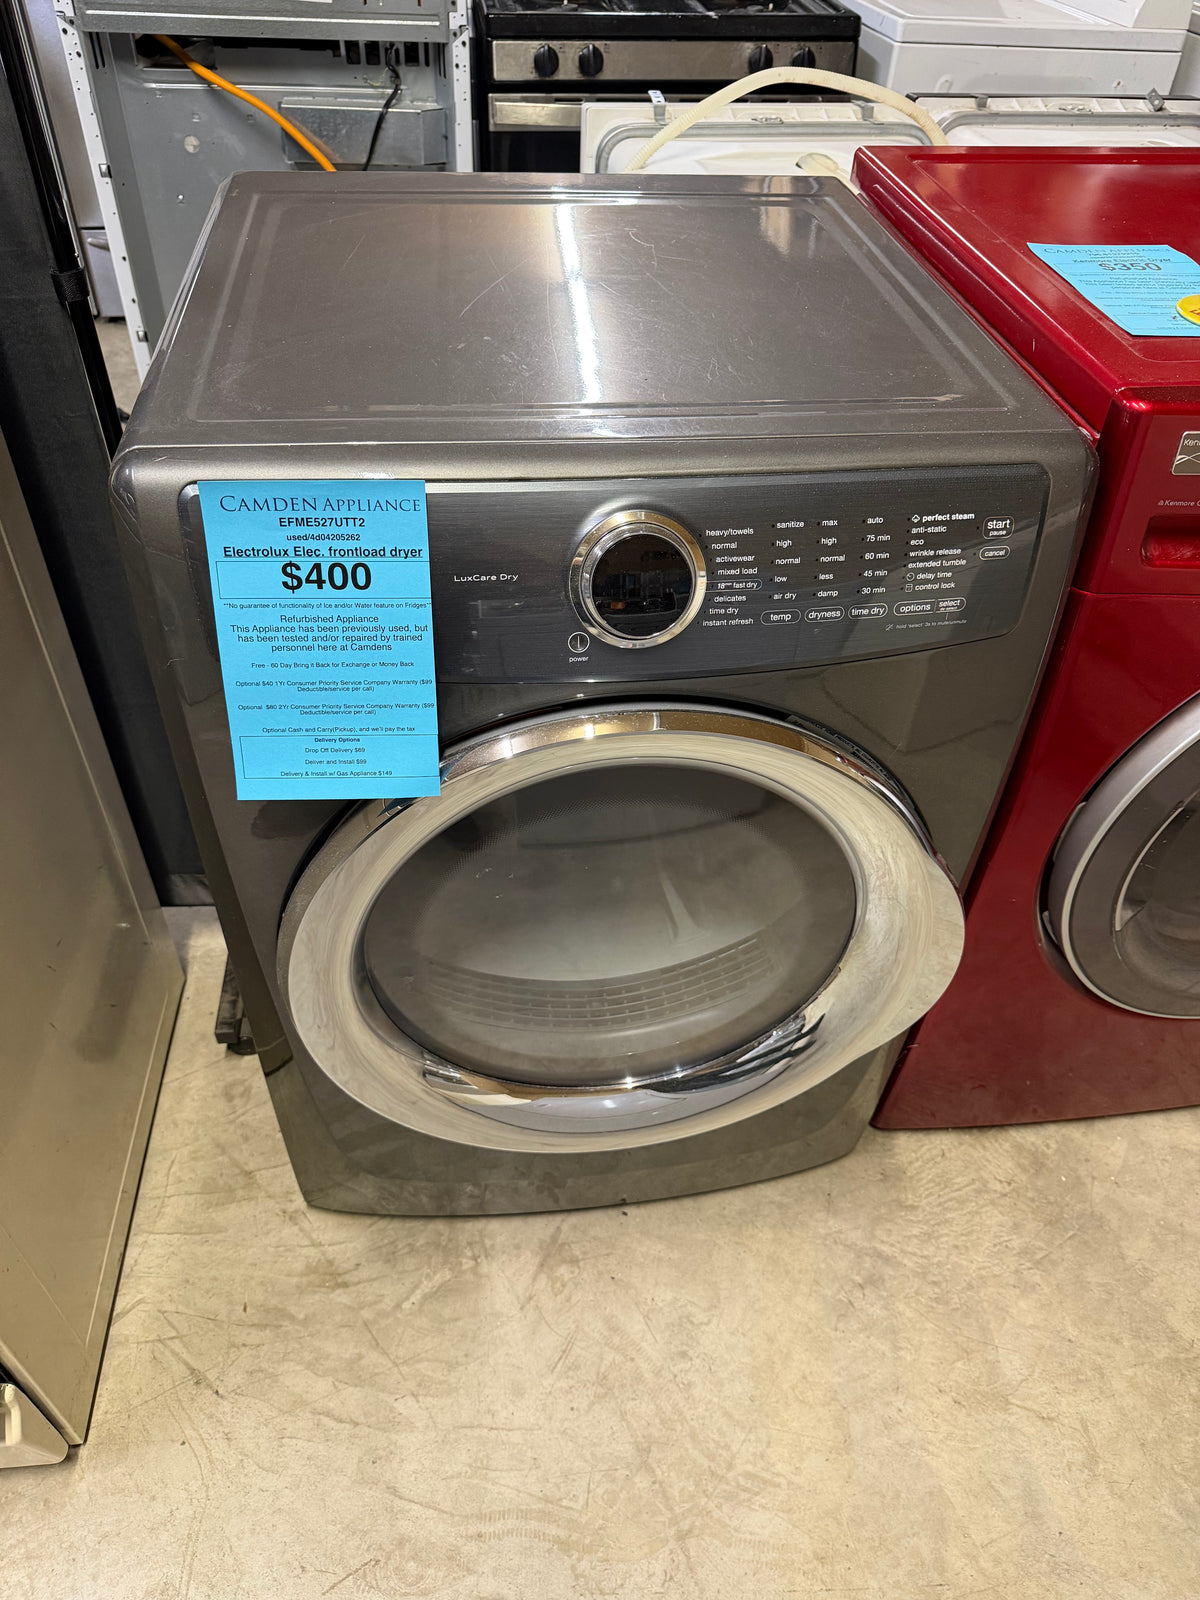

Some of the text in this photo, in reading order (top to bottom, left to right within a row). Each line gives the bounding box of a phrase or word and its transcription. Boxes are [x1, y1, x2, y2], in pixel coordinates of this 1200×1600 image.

[1098, 263, 1162, 271] $350
[220, 496, 421, 512] CAMDEN APPLIANCE
[279, 518, 365, 527] EFME527UTT2
[922, 514, 950, 523] perfect
[987, 520, 1010, 529] start
[706, 528, 754, 537] heavy/towels
[911, 526, 947, 534] anti-static
[286, 533, 360, 542] used/4d04205262
[821, 538, 837, 546] high
[712, 542, 737, 550] normal
[776, 540, 792, 548] high
[223, 546, 422, 559] Electrolux Elec. frontload dryer
[909, 548, 962, 557] wrinkle release
[716, 555, 755, 563] activewear
[776, 557, 800, 565] normal
[908, 560, 940, 569] extended
[718, 568, 739, 576] mixed
[917, 571, 952, 580] delay time
[281, 561, 371, 594] $400
[454, 573, 518, 582] LuxCare Dry
[915, 583, 939, 591] control
[785, 592, 796, 600] dry
[818, 590, 838, 598] damp
[278, 602, 315, 610] functionality
[900, 603, 931, 613] options
[727, 607, 739, 615] dry
[808, 610, 840, 619] dryness
[852, 607, 885, 616] time dry
[280, 615, 379, 625] Refurbished Appliance
[770, 613, 792, 621] temp
[729, 618, 753, 626] refresh
[231, 625, 250, 633] This
[252, 625, 296, 635] Appliance
[299, 625, 314, 633] has
[317, 625, 339, 633] been
[342, 625, 386, 635] previously
[388, 625, 412, 633] used,
[238, 634, 423, 644] has been tested and/or repaired by trained
[272, 644, 315, 653] personnel
[350, 643, 392, 651] Camdens
[379, 661, 398, 669] Money
[363, 679, 390, 687] Company
